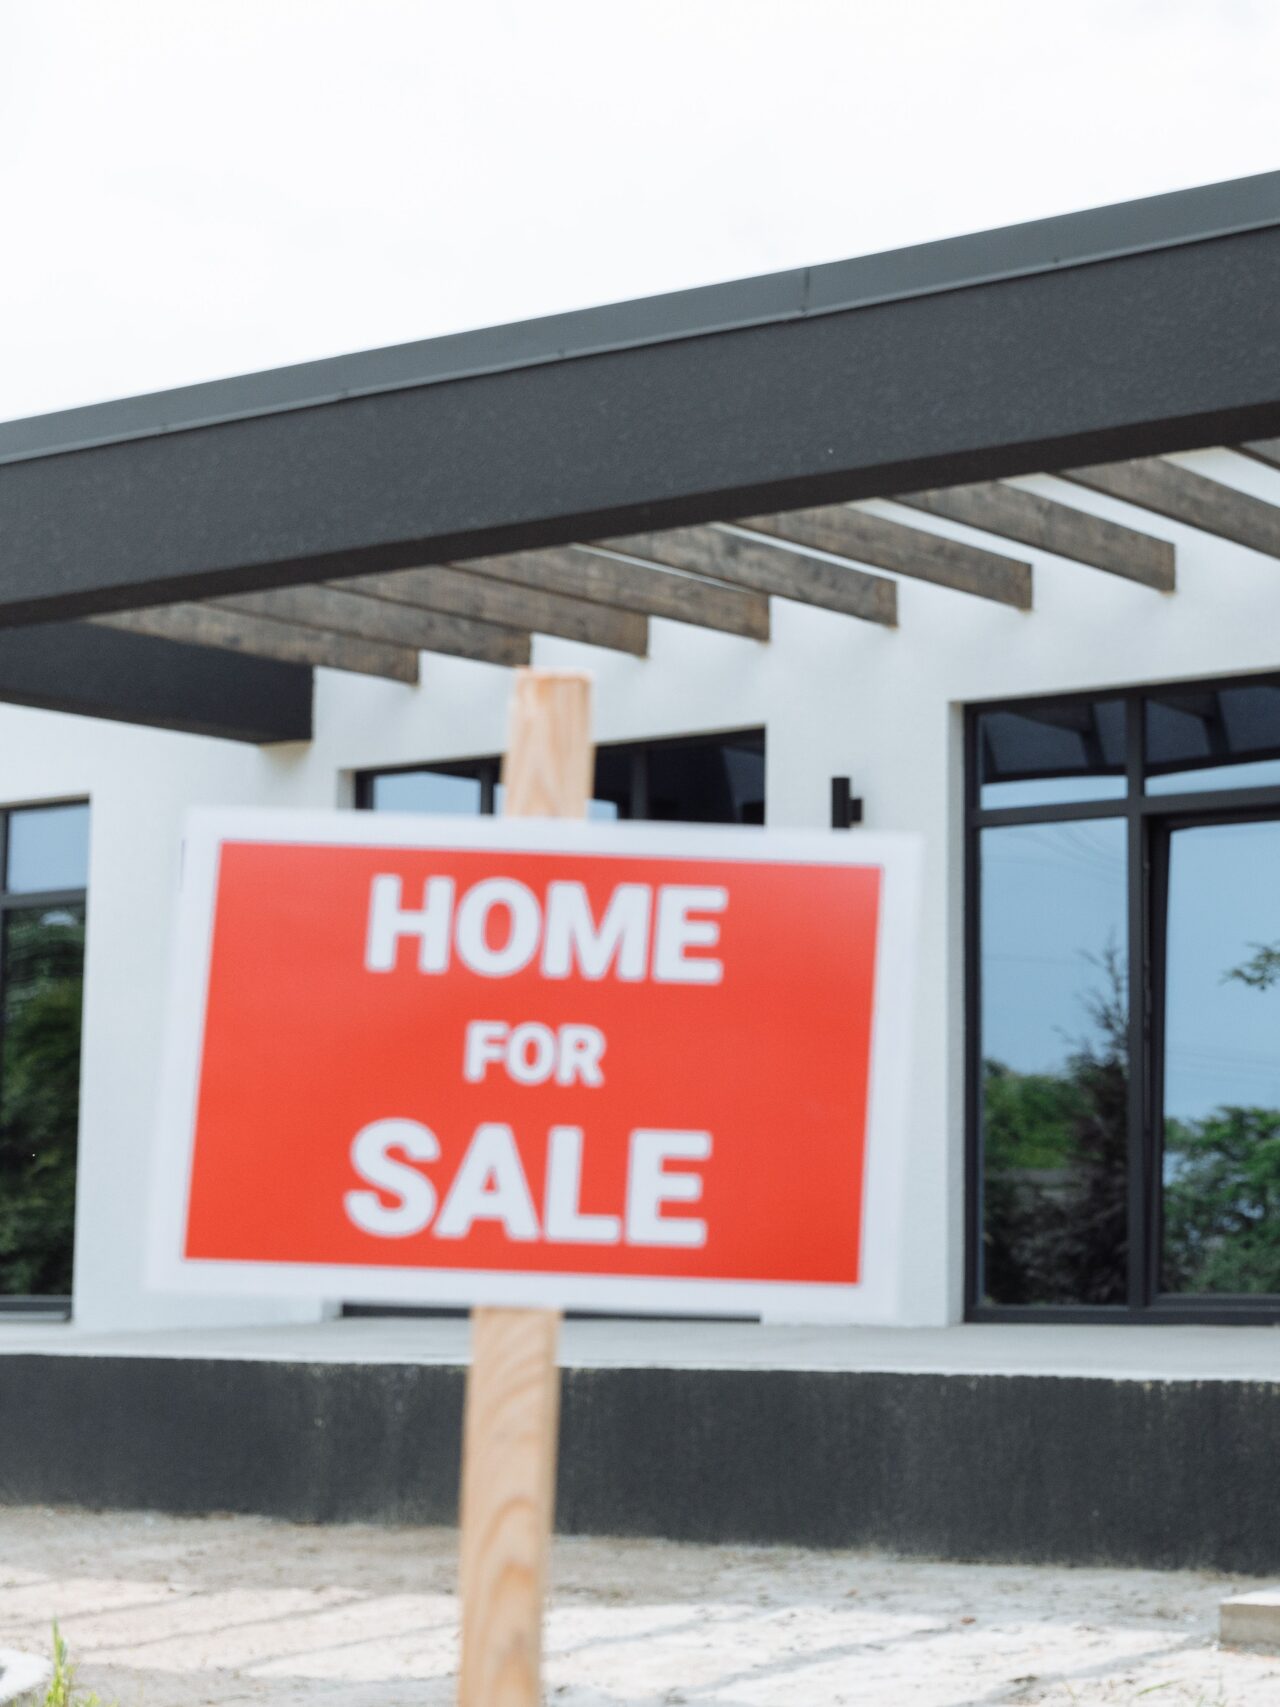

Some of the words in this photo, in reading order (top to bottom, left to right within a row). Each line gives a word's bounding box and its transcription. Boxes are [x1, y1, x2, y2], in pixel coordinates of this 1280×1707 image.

[364, 873, 729, 984] HOME
[463, 1020, 606, 1087] FOR
[343, 1118, 712, 1248] SALE
